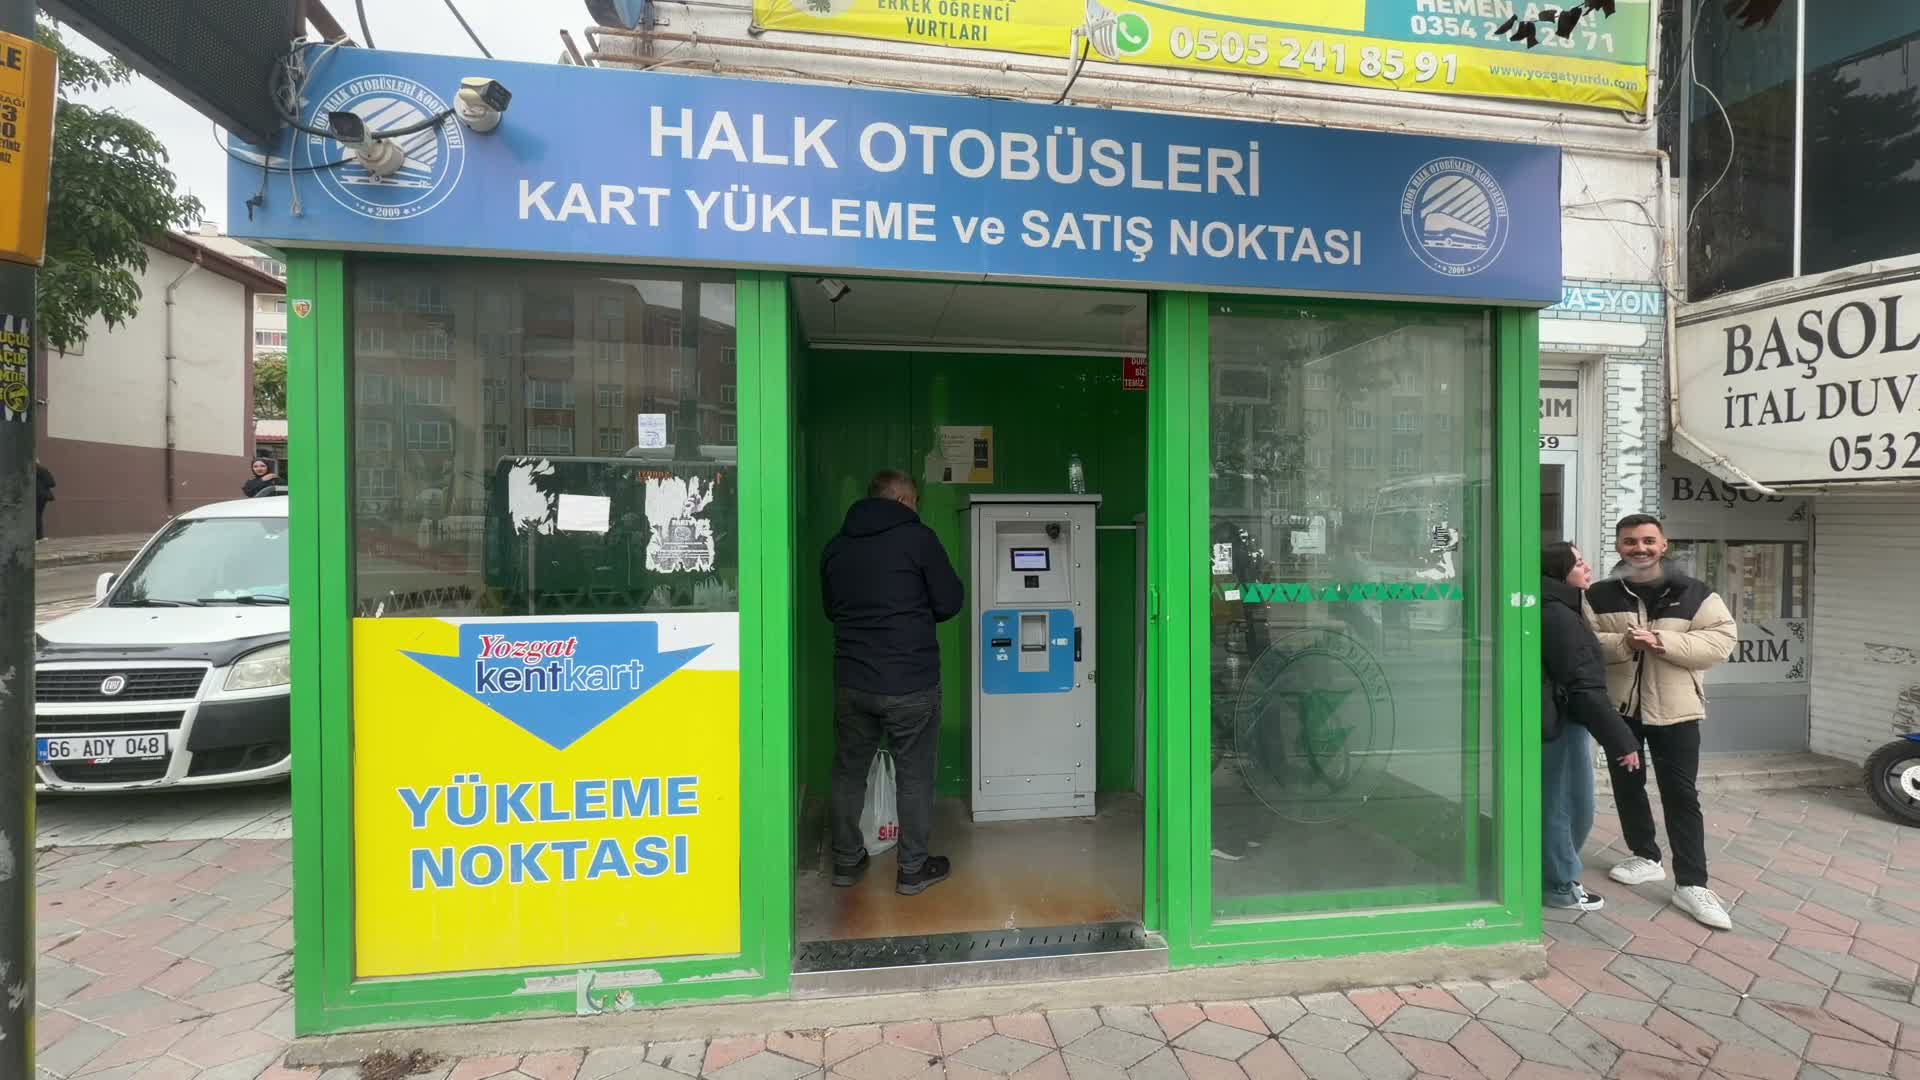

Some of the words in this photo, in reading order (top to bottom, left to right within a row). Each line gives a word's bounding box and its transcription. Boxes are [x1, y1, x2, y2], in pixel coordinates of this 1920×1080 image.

[878, 0, 932, 14] ERKEK
[1416, 0, 1514, 18] HEMEN
[906, 16, 988, 42] YURTLARI
[1411, 15, 1478, 39] 0354
[1169, 26, 1270, 66] 0505
[1279, 39, 1345, 74] 241
[1359, 46, 1406, 81] 85
[1415, 51, 1458, 85] 91
[1489, 64, 1638, 91] www.yozgatyurdu.com
[310, 110, 330, 145] BZOK
[323, 87, 352, 112] HALK
[350, 76, 417, 96] OTOBÜSLERİ
[415, 89, 464, 149] KOOPRATİFİ
[650, 105, 839, 169] HALK
[859, 121, 1260, 198] OTOBÜSLERİ
[1415, 167, 1431, 188] HALK
[1430, 159, 1475, 174] OTOBÜSLERİ
[376, 207, 401, 217] 2009
[518, 179, 671, 227] KART
[684, 184, 937, 243] YÜKLEME
[952, 214, 1005, 245] ve
[1021, 209, 1153, 263] SATIŞ
[1169, 219, 1362, 266] NOKTASI
[1447, 266, 1465, 274] 2009
[1723, 295, 1920, 380] BAŞOL
[1724, 386, 1806, 429] İTAL
[1816, 374, 1920, 420] DUV
[1829, 431, 1920, 472] 0532
[478, 635, 578, 666] Yozgat
[475, 657, 645, 694] kentkart
[48, 741, 70, 758] 66
[83, 739, 115, 757] ADY
[126, 737, 159, 755] 048
[396, 772, 700, 830] YÜKLEME
[409, 833, 690, 890] NOKTASI
